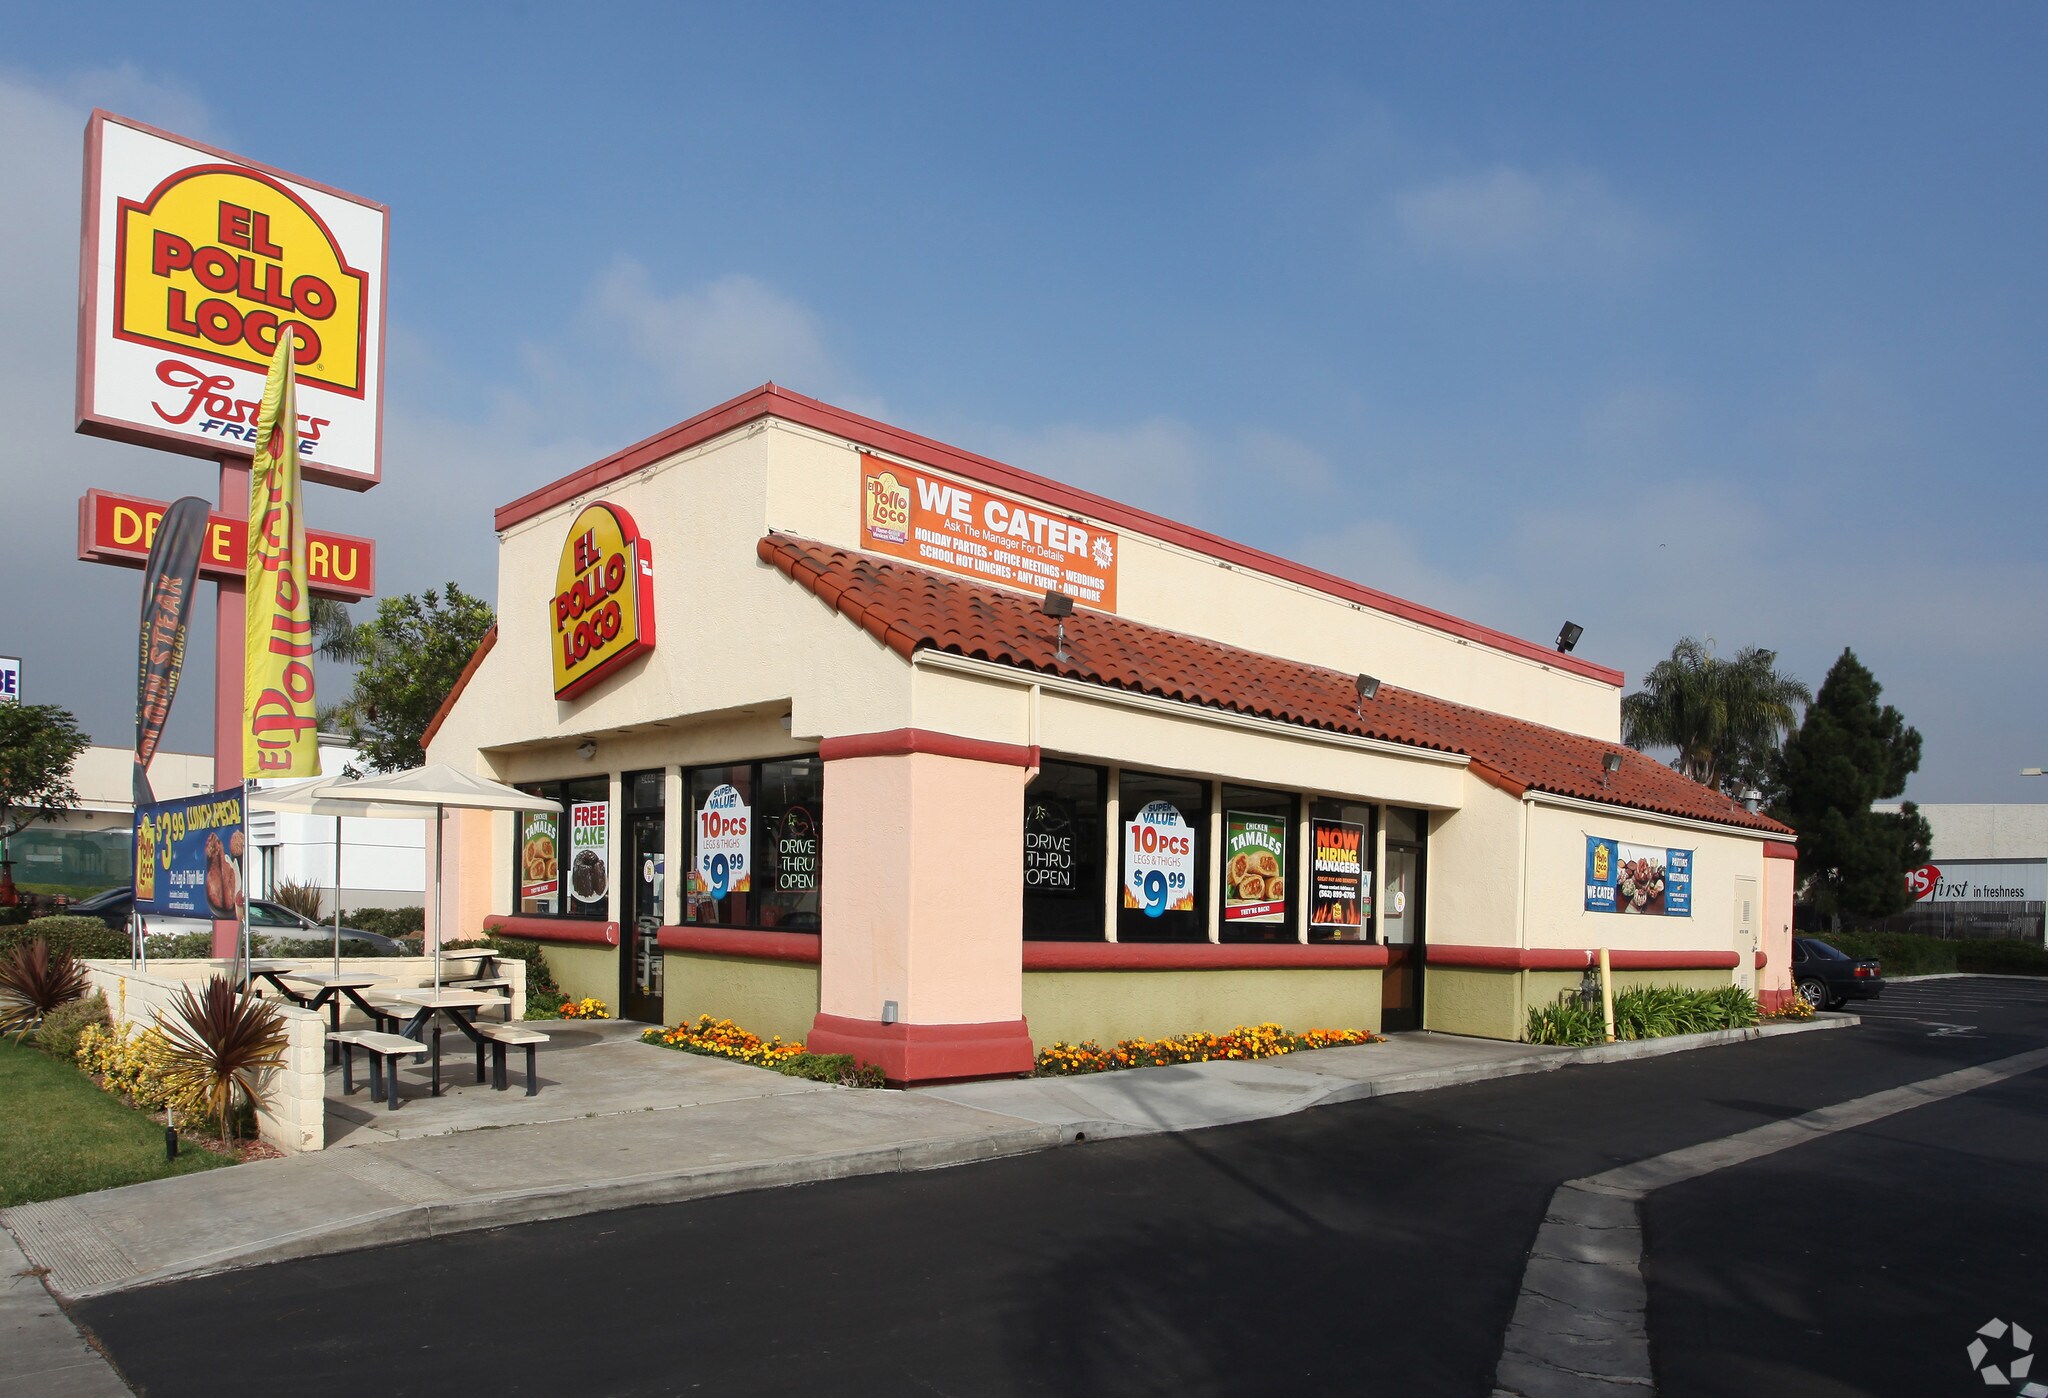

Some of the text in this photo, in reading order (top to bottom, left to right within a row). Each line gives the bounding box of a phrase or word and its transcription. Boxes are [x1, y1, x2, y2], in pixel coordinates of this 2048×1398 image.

[218, 200, 283, 261] EL
[152, 229, 337, 321] POLLO
[166, 287, 322, 366] LOCO
[872, 480, 907, 510] Pollo
[873, 502, 907, 525] Loco
[916, 477, 1088, 558] WE CATER
[574, 527, 602, 577] EL
[944, 518, 1065, 563] Ask The Manager For Details
[915, 527, 1105, 591] HOLIDAY PARTIES OFFICE MEETINGS WEDDINGS
[919, 543, 1101, 603] SCHOOL HOT LUNCHES ANY EVENT AND MORE
[556, 552, 626, 633] POLLO
[150, 573, 183, 669] STEAK
[171, 623, 186, 668] HEADS
[563, 600, 622, 671] LOCO
[252, 569, 318, 743] Pollo
[257, 739, 291, 771] El
[710, 794, 738, 810] VALUE!
[714, 784, 732, 798] SUPER
[187, 798, 241, 831] LUNCH SPECIAL
[574, 805, 606, 826] FREE
[1143, 812, 1178, 826] VALUE!
[1148, 803, 1172, 812] SUPER
[525, 821, 556, 839] TAMALES
[574, 826, 605, 846] CAKE
[702, 811, 747, 838] 10 PCS
[1246, 823, 1268, 833] CHICKEN
[703, 840, 716, 850] LEGS
[721, 838, 740, 848] THIGHS
[780, 840, 816, 854] DRIVE
[1026, 833, 1071, 852] DRIVE
[1131, 825, 1189, 855] 10 PCS
[1230, 832, 1282, 856] TAMALES
[1317, 826, 1360, 850] NOW
[782, 856, 815, 872] THRU
[1026, 850, 1070, 868] THRU
[1134, 855, 1181, 867] LEGS & THIGHS
[1317, 846, 1357, 863] HIRING
[1026, 868, 1070, 886] OPEN
[1316, 860, 1360, 874] MANAGERS
[780, 874, 814, 888] OPEN
[1927, 876, 1968, 904] first
[1974, 886, 1980, 897] in
[1984, 885, 2024, 898] freshness
[1319, 890, 1332, 898] (562)
[1587, 885, 1615, 901] WE CATER
[1240, 908, 1257, 916] THEY'RE
